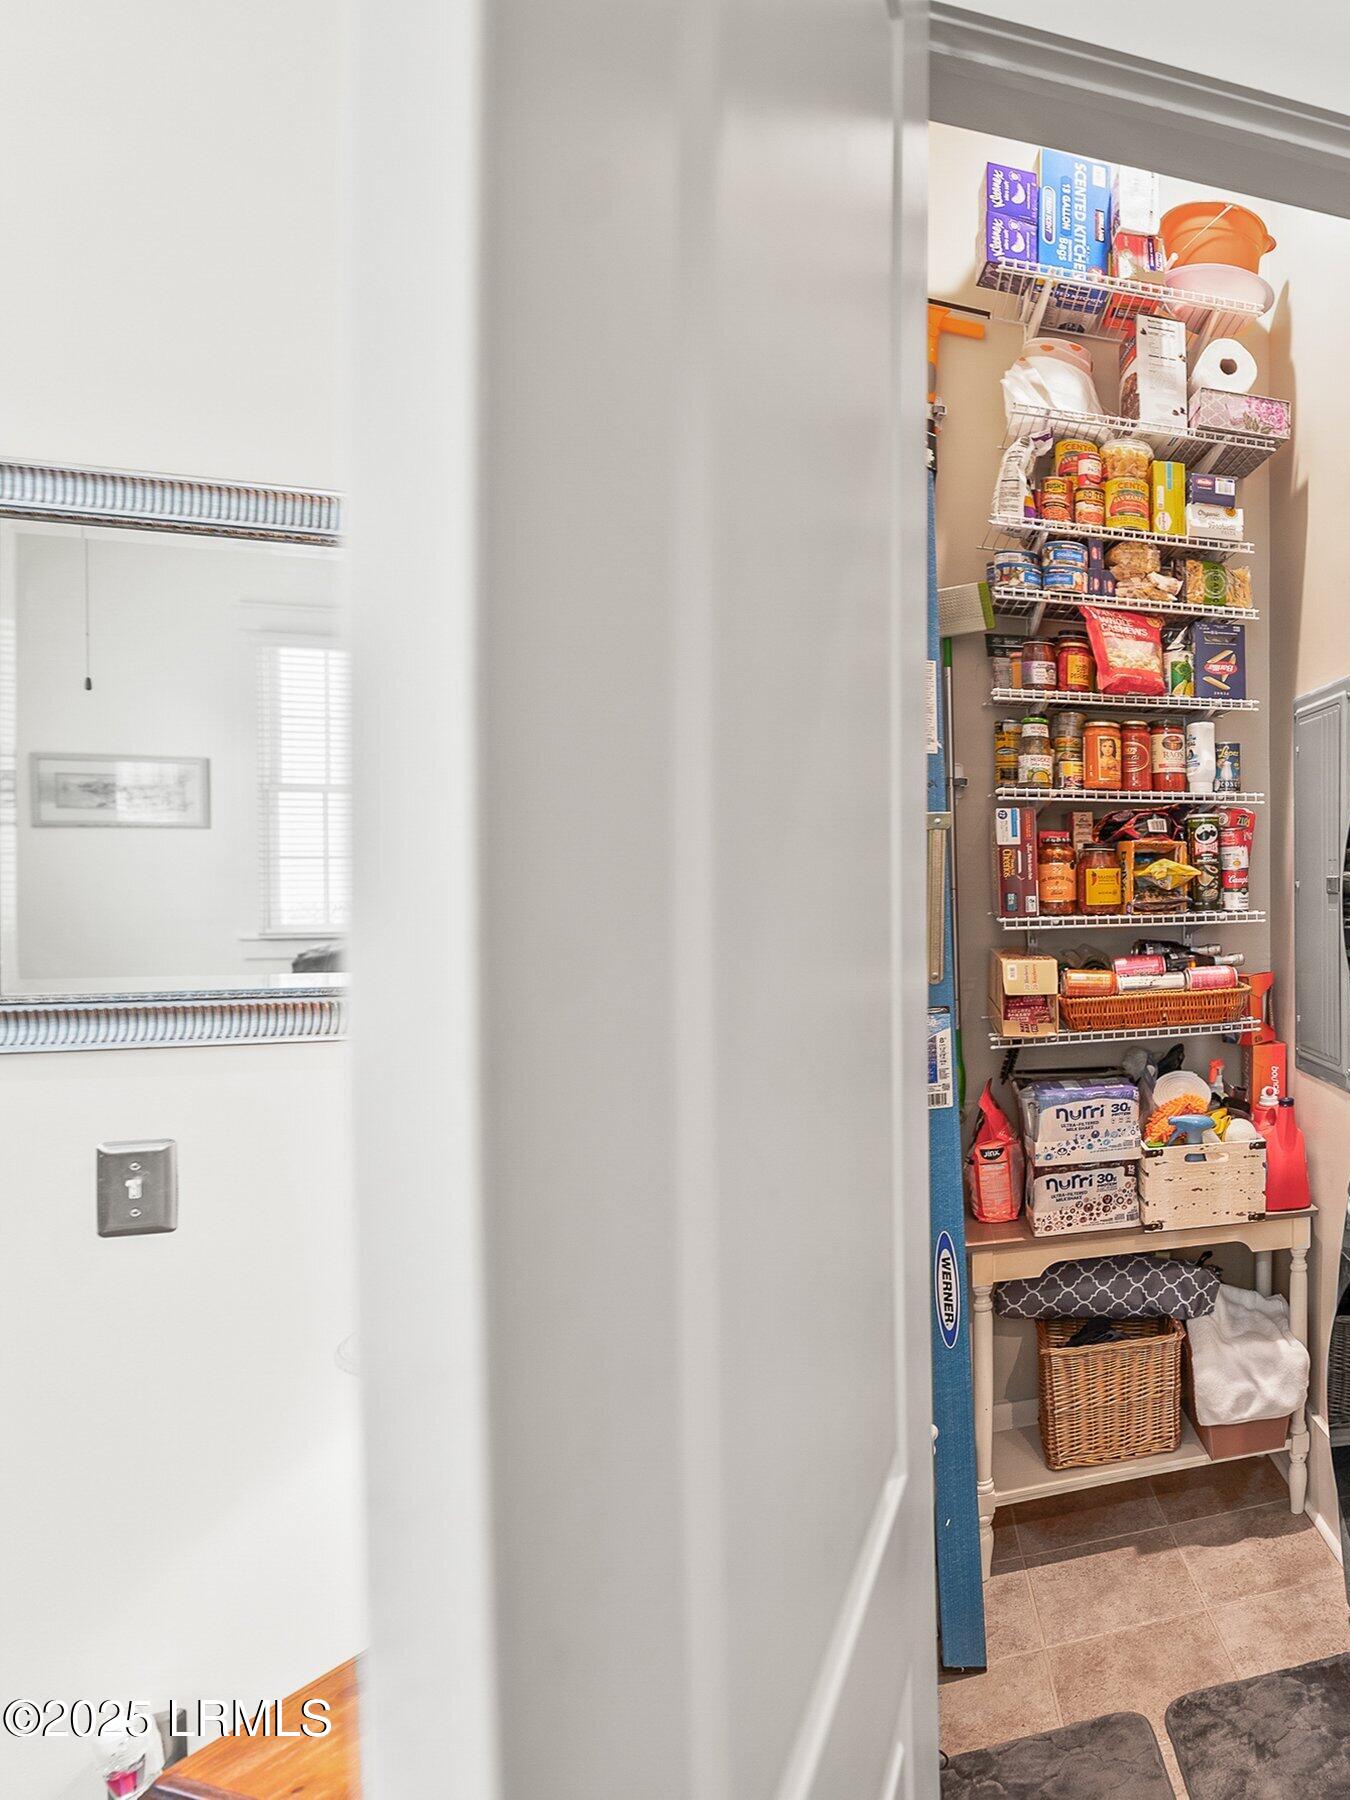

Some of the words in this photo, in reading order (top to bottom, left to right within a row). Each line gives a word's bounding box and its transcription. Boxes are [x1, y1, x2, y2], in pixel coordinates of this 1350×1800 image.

[989, 169, 1005, 208] Kleenex
[1061, 183, 1071, 194] 13
[1074, 162, 1087, 222] SCENTED
[1061, 194, 1071, 231] GALLON
[989, 218, 1005, 257] Kleenex
[1056, 236, 1067, 261] Bags
[1117, 481, 1145, 492] CENTO
[1197, 509, 1219, 517] Organic
[1100, 615, 1134, 627] WHOLE
[1100, 623, 1148, 637] CASHEWS
[1207, 664, 1234, 672] Barilla
[1002, 848, 1011, 880] Cheerios
[1055, 1104, 1105, 1122] nurri
[1061, 1120, 1100, 1128] ULTRA-FILTERED
[1127, 1164, 1135, 1172] 12
[1045, 1174, 1093, 1192] nurri
[1051, 1190, 1088, 1199] ULTRA-FILTERED
[941, 1256, 954, 1324] WERNER
